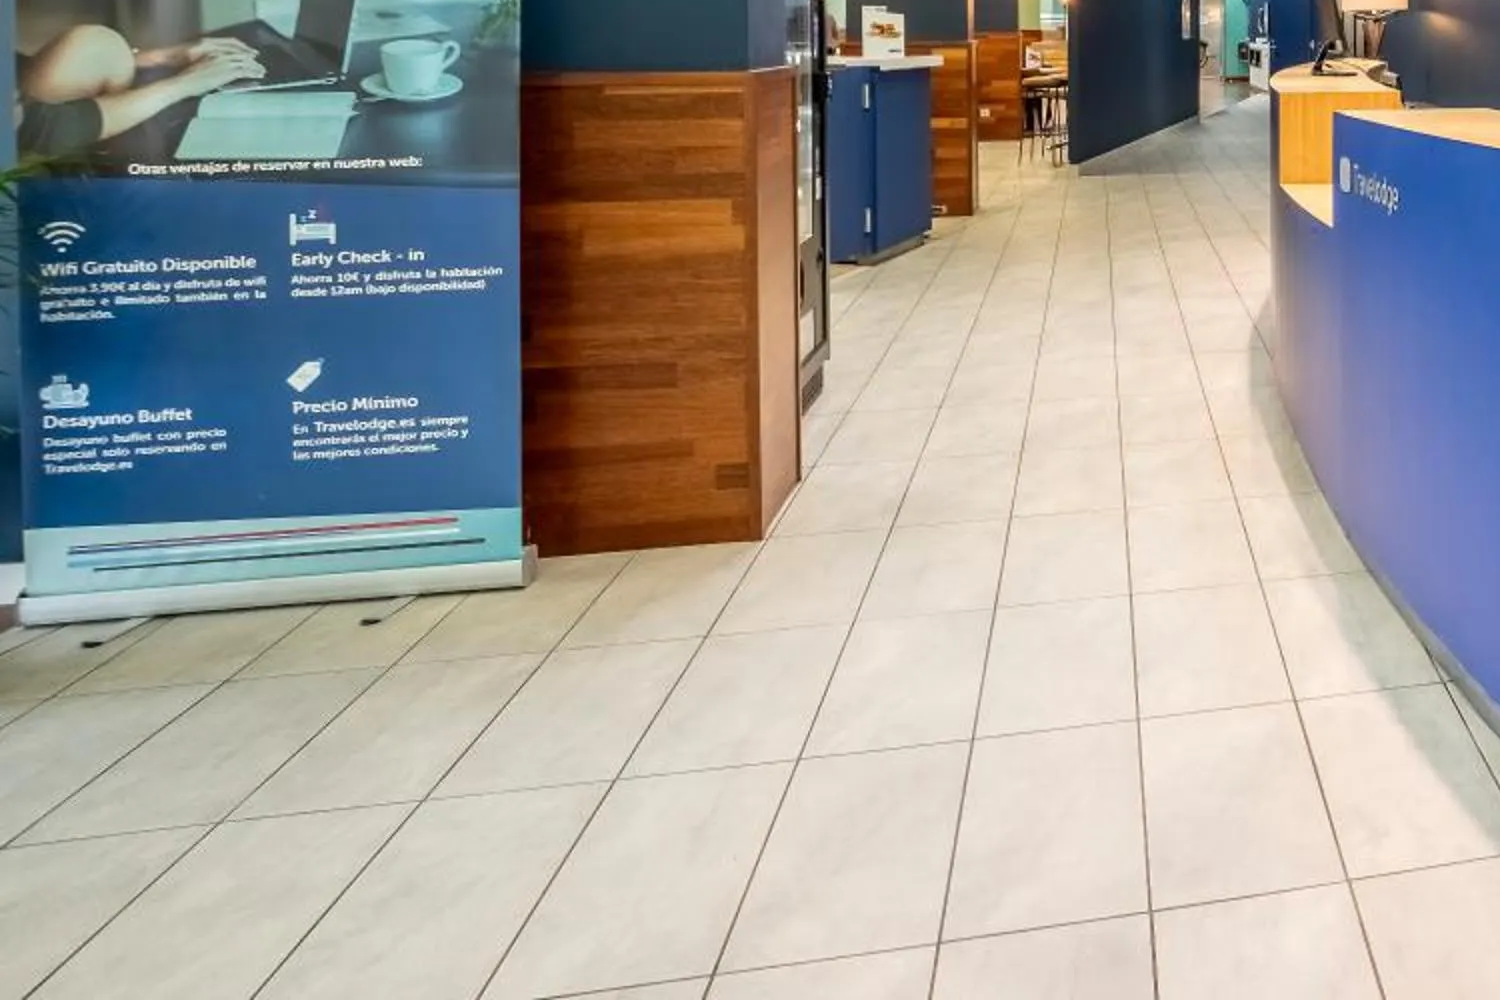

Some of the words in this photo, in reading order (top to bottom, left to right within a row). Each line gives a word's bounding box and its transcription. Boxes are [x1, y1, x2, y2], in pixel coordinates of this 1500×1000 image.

[128, 163, 167, 175] Otras
[169, 162, 229, 175] ventajas
[231, 161, 250, 173] de
[253, 160, 311, 173] reservar
[313, 160, 332, 170] en
[333, 158, 386, 170] nuestra
[40, 261, 78, 277] Wifi
[82, 259, 158, 276] Gratuito
[162, 256, 257, 274] Disponible
[291, 252, 334, 269] Early
[337, 250, 392, 265] Check
[407, 248, 425, 263] in
[291, 273, 333, 286] Ahorra
[375, 270, 421, 283] disfruta
[291, 286, 328, 298] desde
[292, 399, 348, 415] Precio
[42, 412, 134, 430] Desayuno
[137, 407, 193, 424] Buffet
[156, 430, 182, 442] con
[293, 423, 309, 435] En
